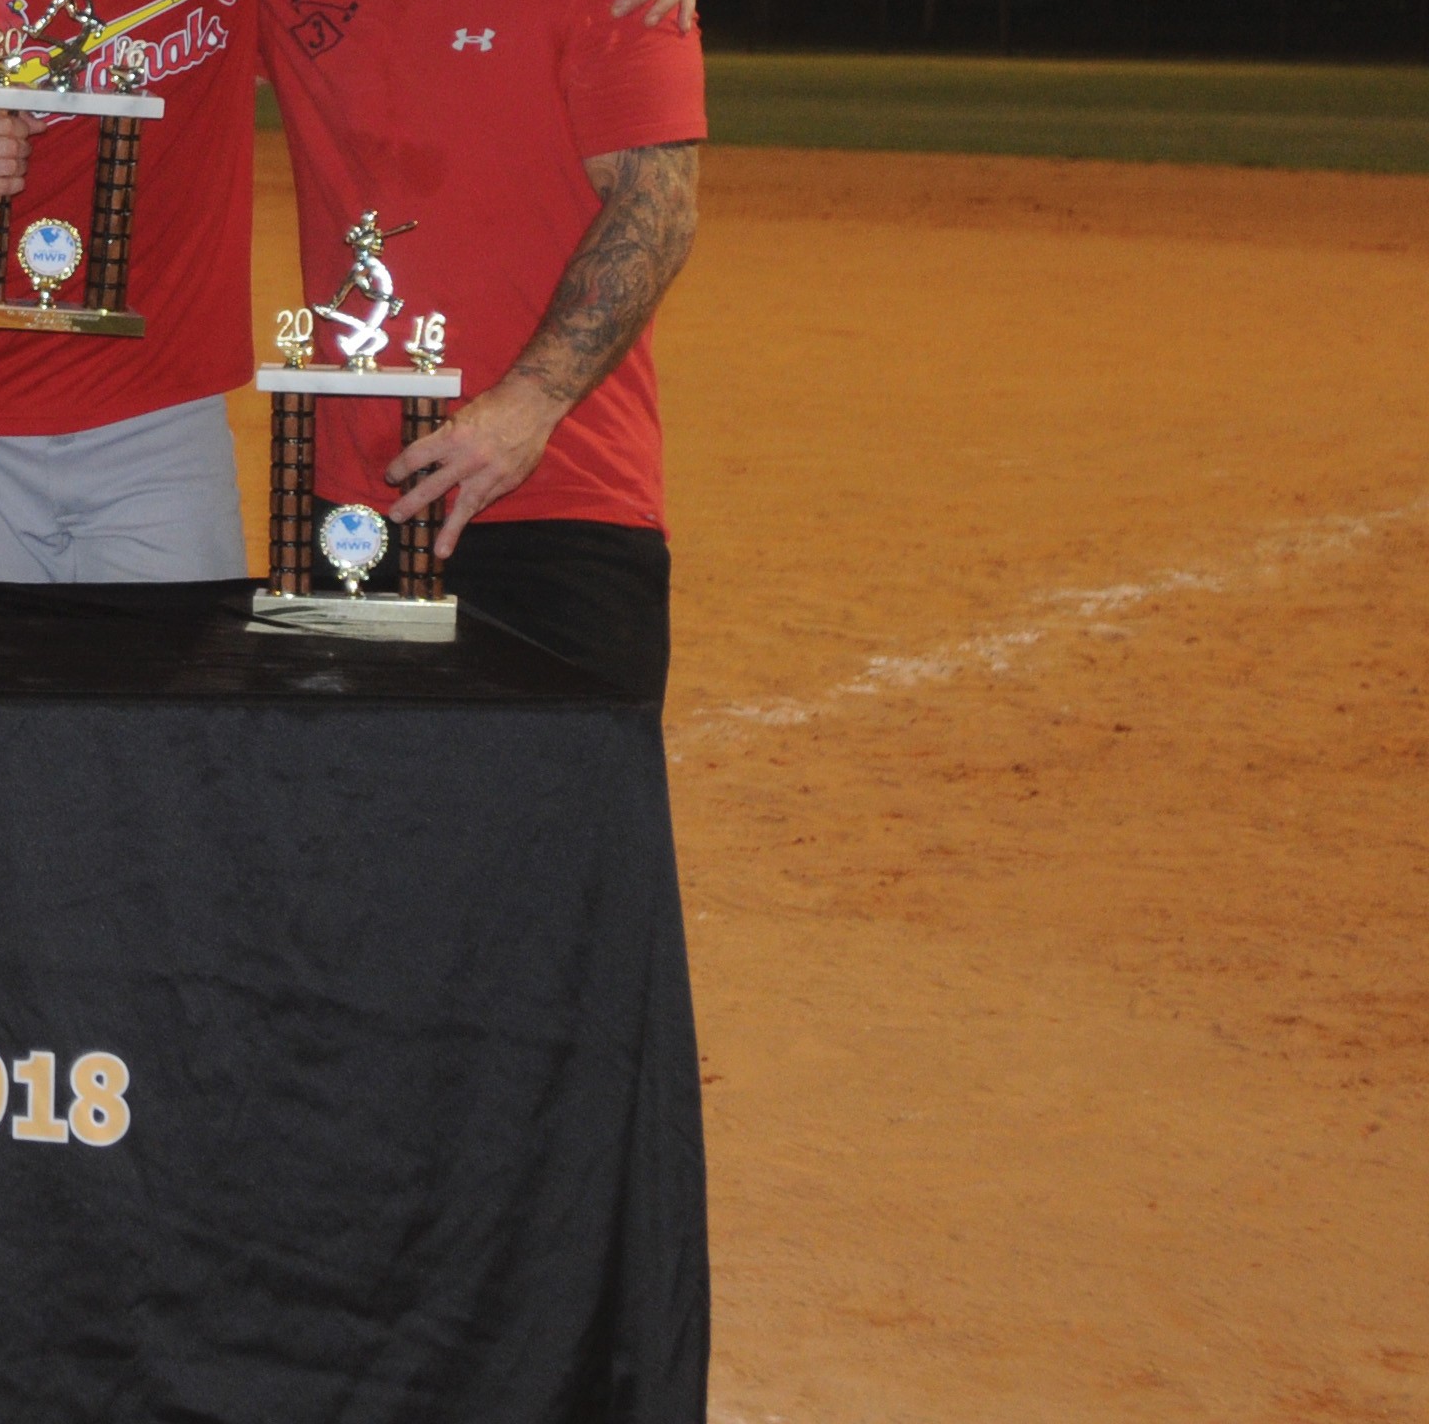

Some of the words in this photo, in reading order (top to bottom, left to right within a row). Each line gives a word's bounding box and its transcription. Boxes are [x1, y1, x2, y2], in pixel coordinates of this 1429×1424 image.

[118, 39, 147, 66] 16
[32, 249, 68, 264] MWR
[276, 308, 314, 341] 20
[412, 313, 446, 346] 16
[335, 538, 372, 553] MWR
